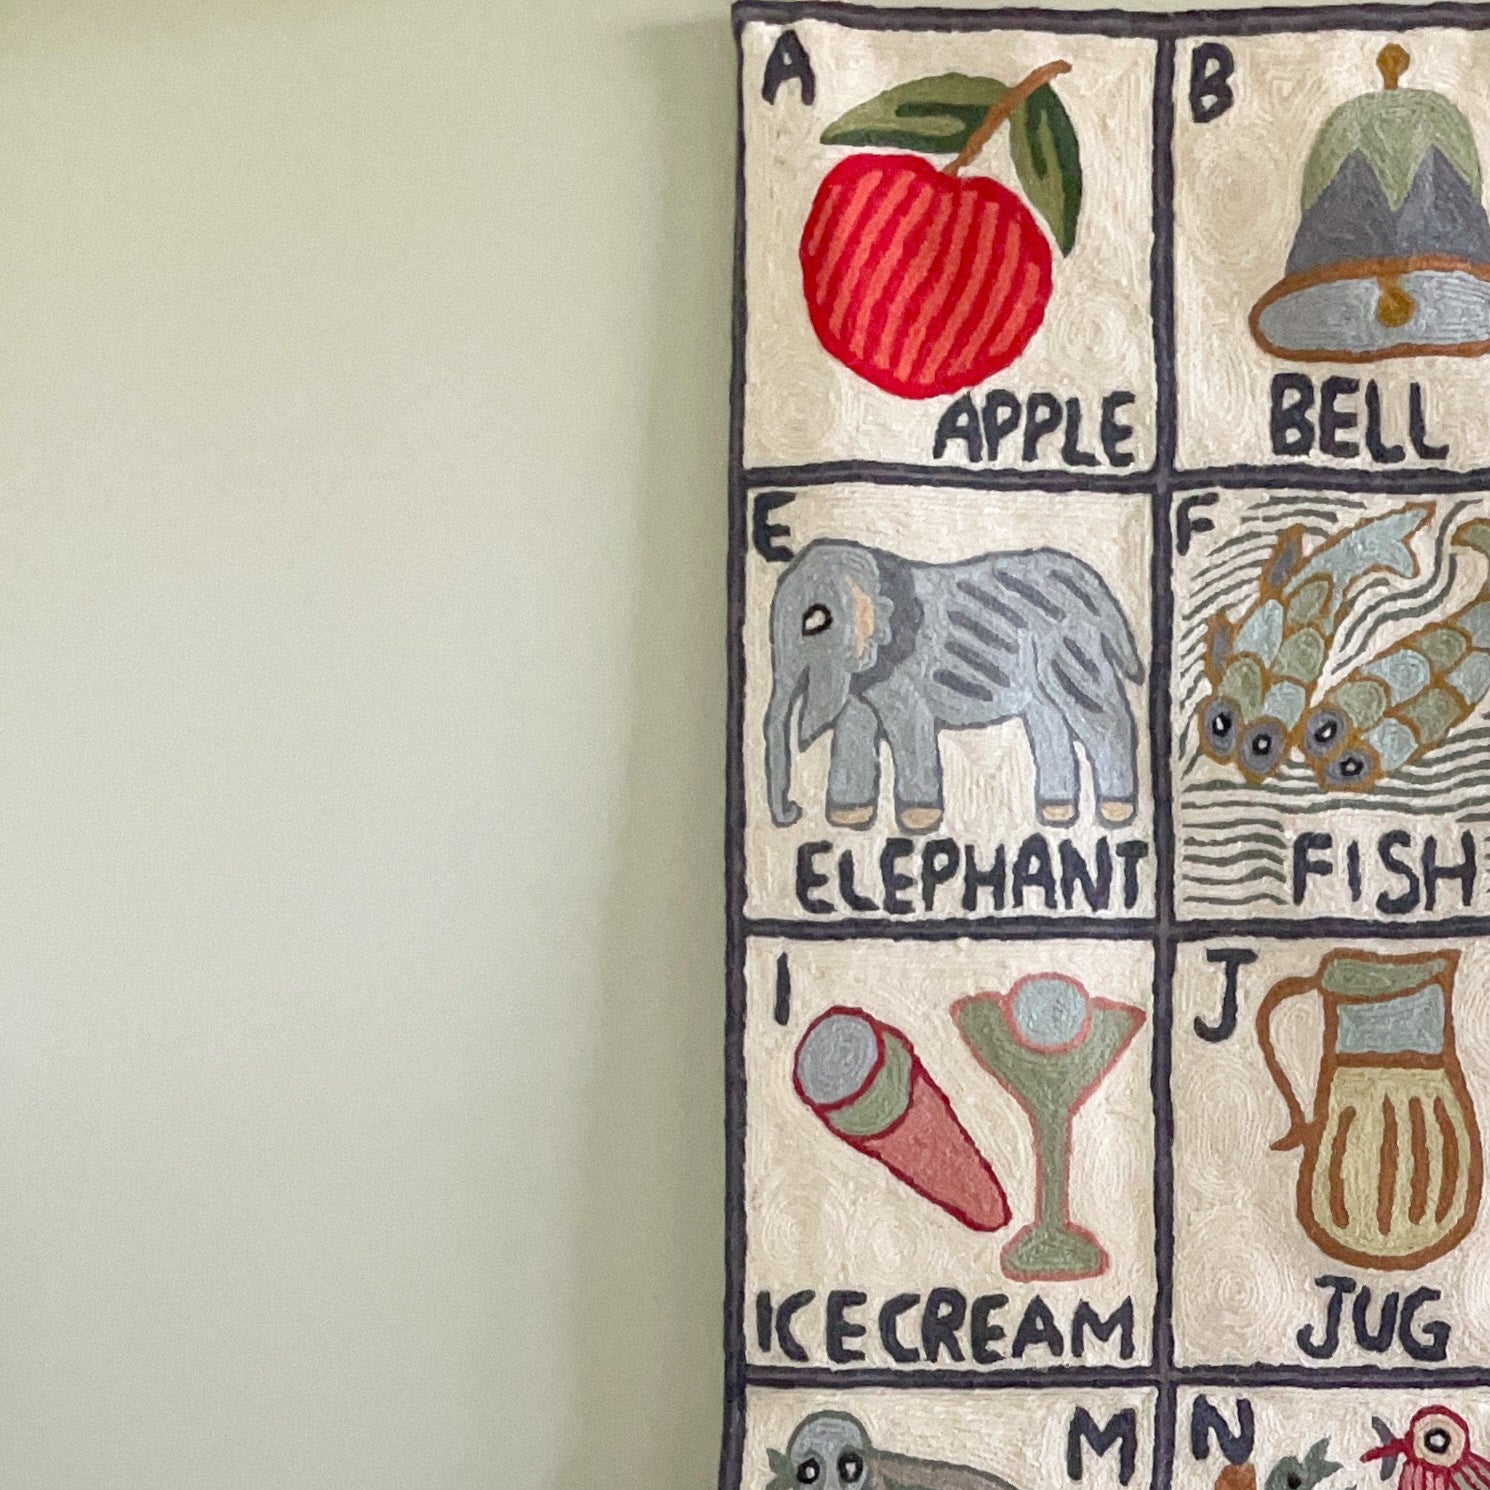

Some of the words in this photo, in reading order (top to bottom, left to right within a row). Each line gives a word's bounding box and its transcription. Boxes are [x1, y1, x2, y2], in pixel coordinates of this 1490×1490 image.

[762, 30, 815, 104] A
[1189, 43, 1234, 123] B
[933, 390, 1134, 467] APPLE
[1271, 373, 1448, 463] BELL
[752, 491, 796, 560] E
[1177, 493, 1218, 555] F
[796, 834, 1148, 914] ELEPHANT
[1293, 830, 1476, 914] FISH
[774, 953, 790, 1025] I
[1194, 948, 1257, 1042] J
[1297, 1275, 1451, 1362] JUG
[1067, 1407, 1137, 1486] M
[1191, 1394, 1254, 1466] N
